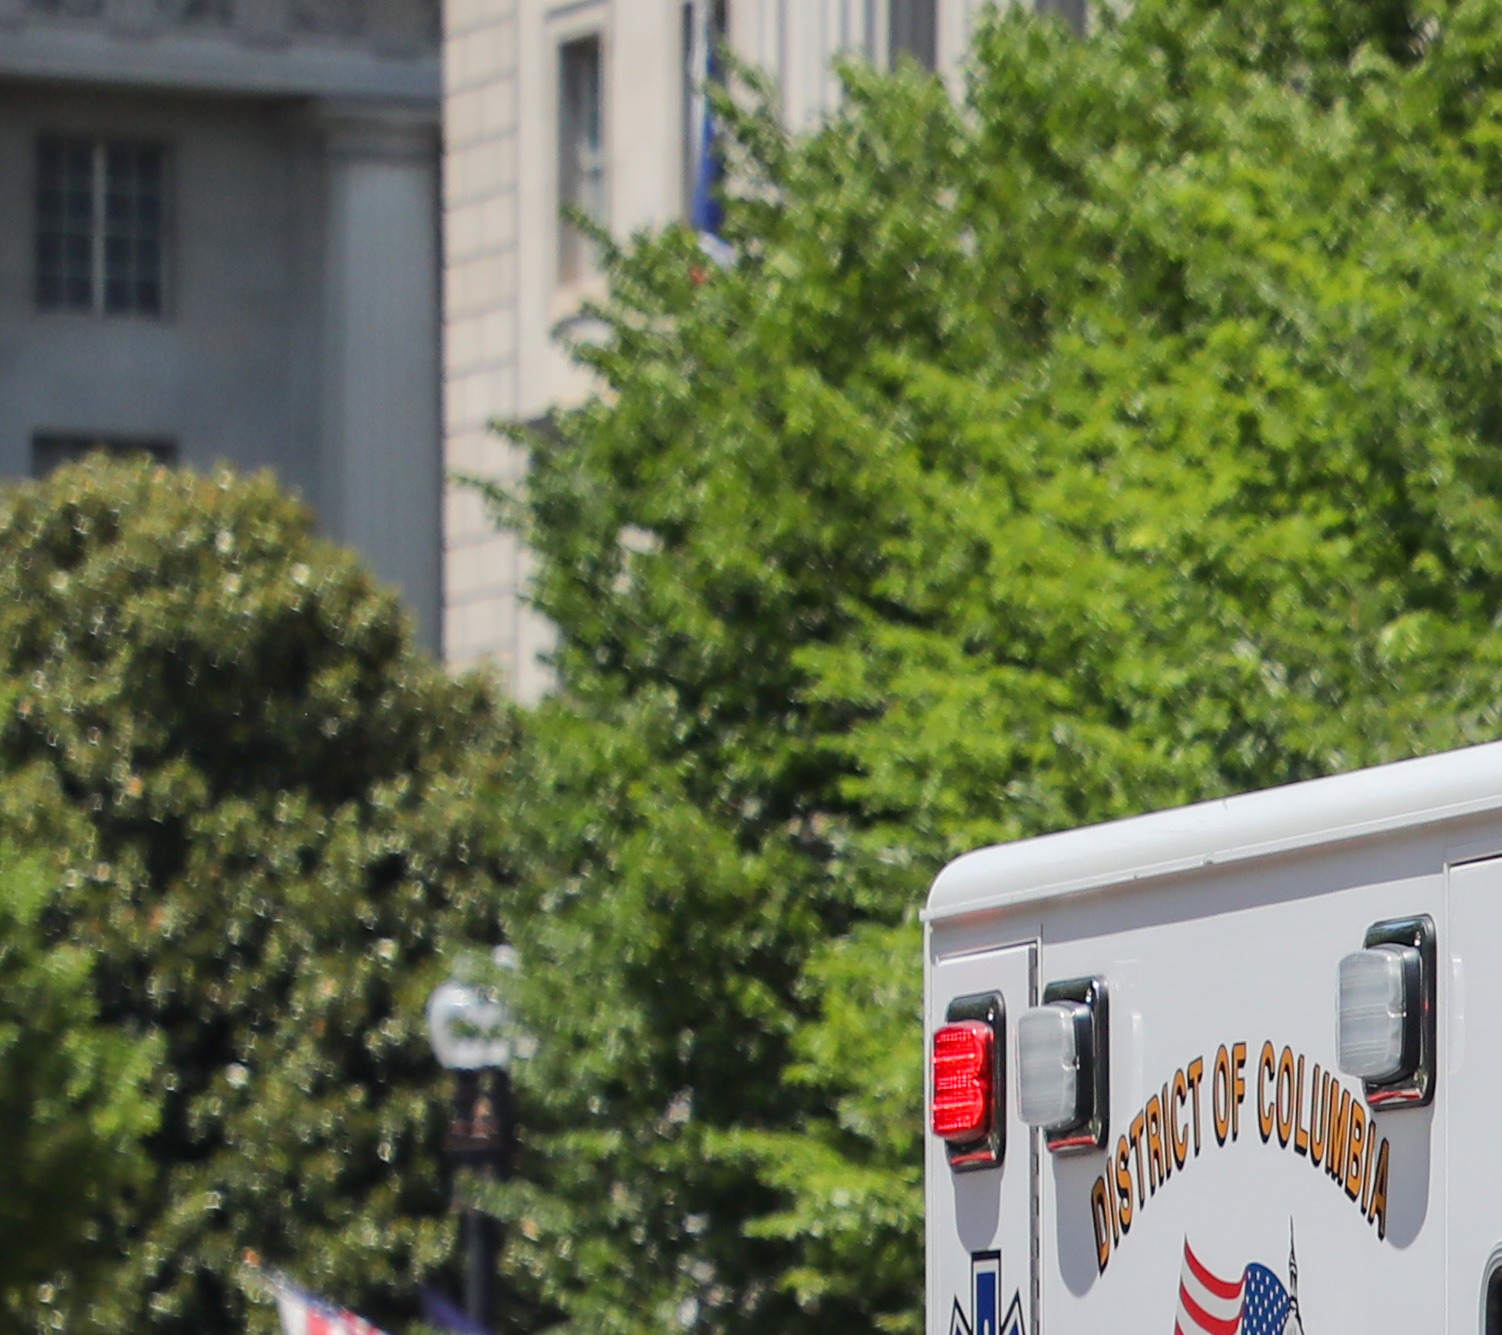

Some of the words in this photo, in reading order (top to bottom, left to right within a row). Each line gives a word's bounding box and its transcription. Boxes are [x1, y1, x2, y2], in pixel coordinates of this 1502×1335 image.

[1091, 1056, 1203, 1278] DISTRICT
[1212, 1042, 1246, 1148] OF
[1257, 1040, 1390, 1241] COLUMBIA
